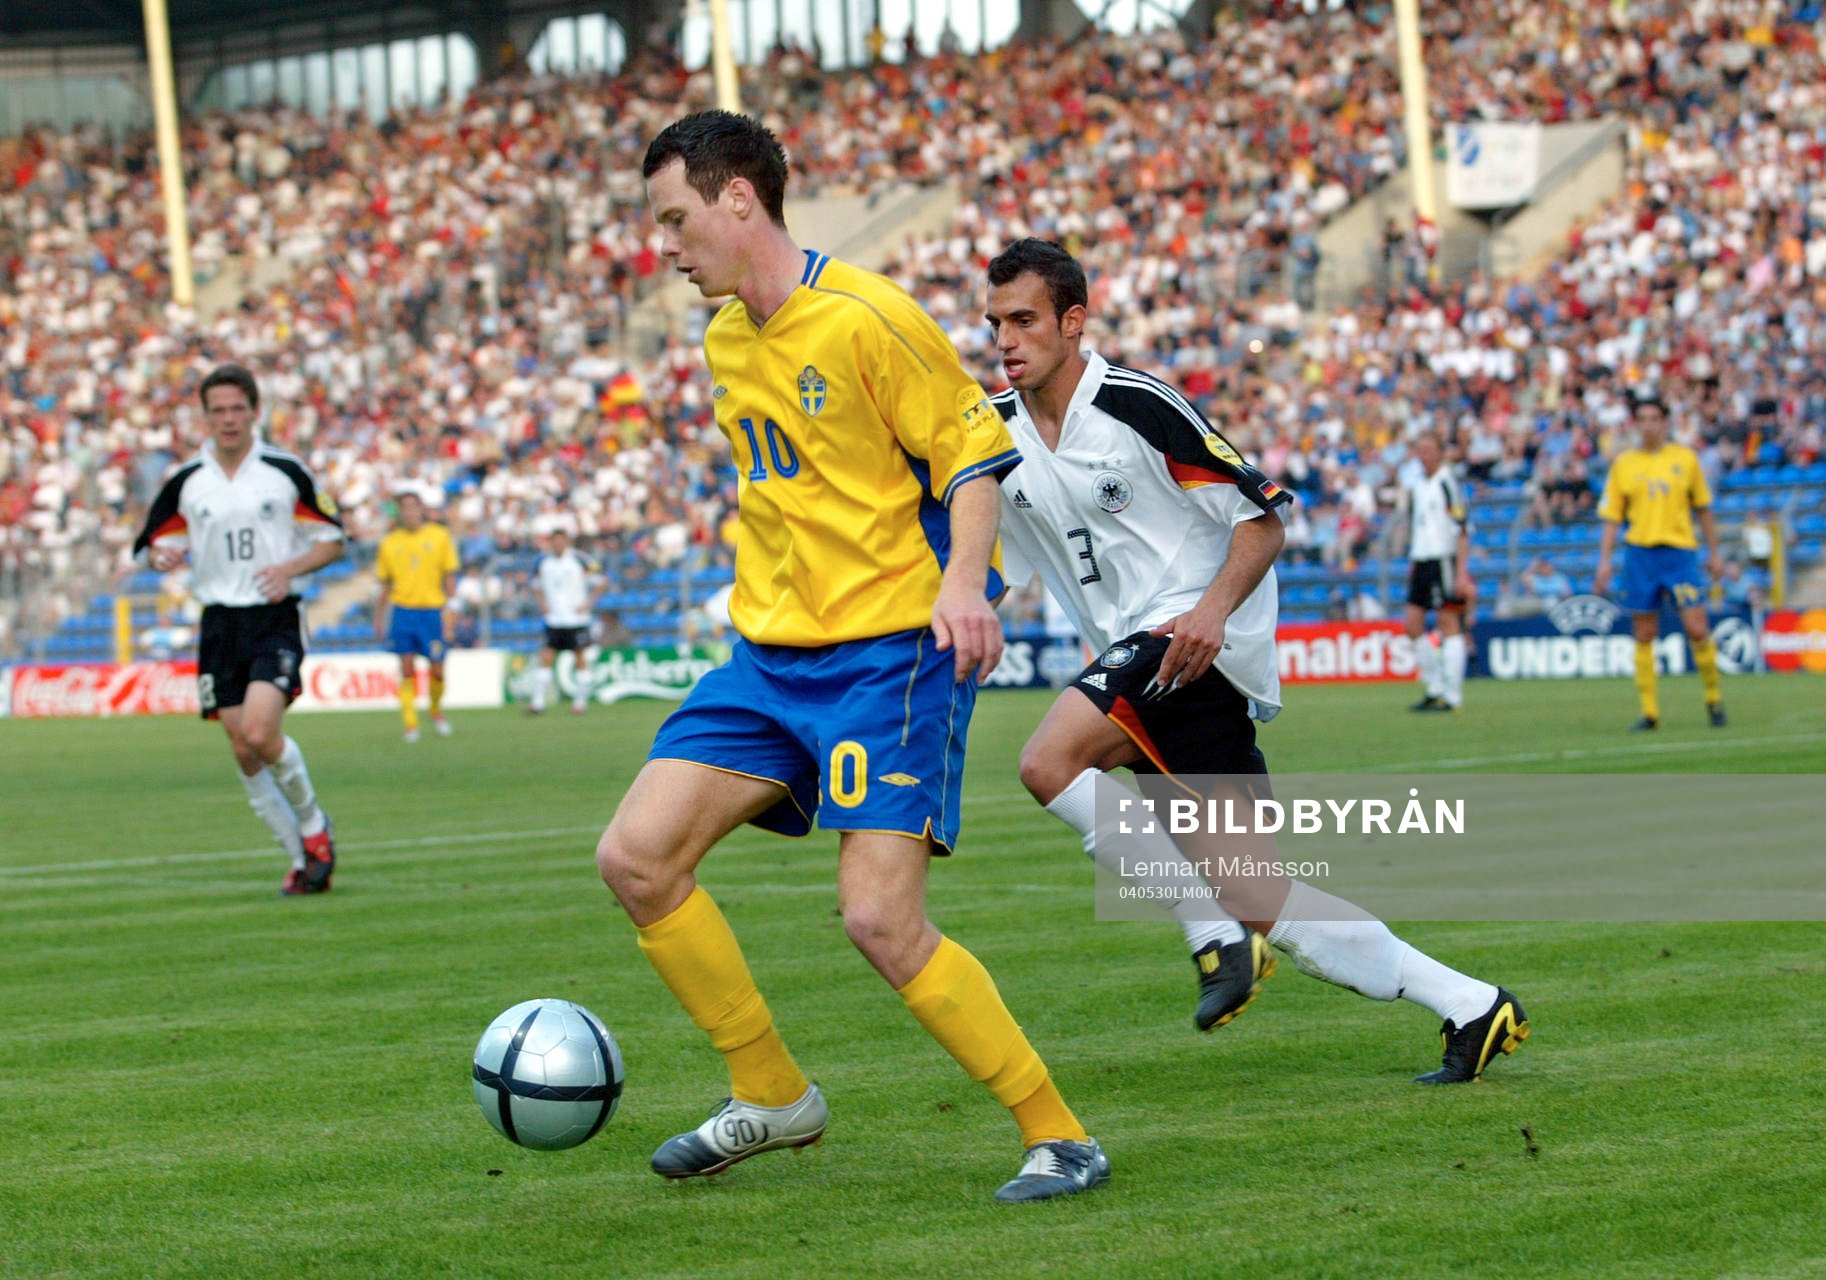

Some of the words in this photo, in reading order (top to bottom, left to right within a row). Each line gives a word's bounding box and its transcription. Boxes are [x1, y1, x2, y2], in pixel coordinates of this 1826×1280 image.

[738, 416, 800, 482] 10
[224, 527, 255, 563] 18
[1067, 527, 1102, 587] 3
[1278, 631, 1417, 679] nald's
[818, 740, 868, 809] 0
[724, 1118, 757, 1147] 90
